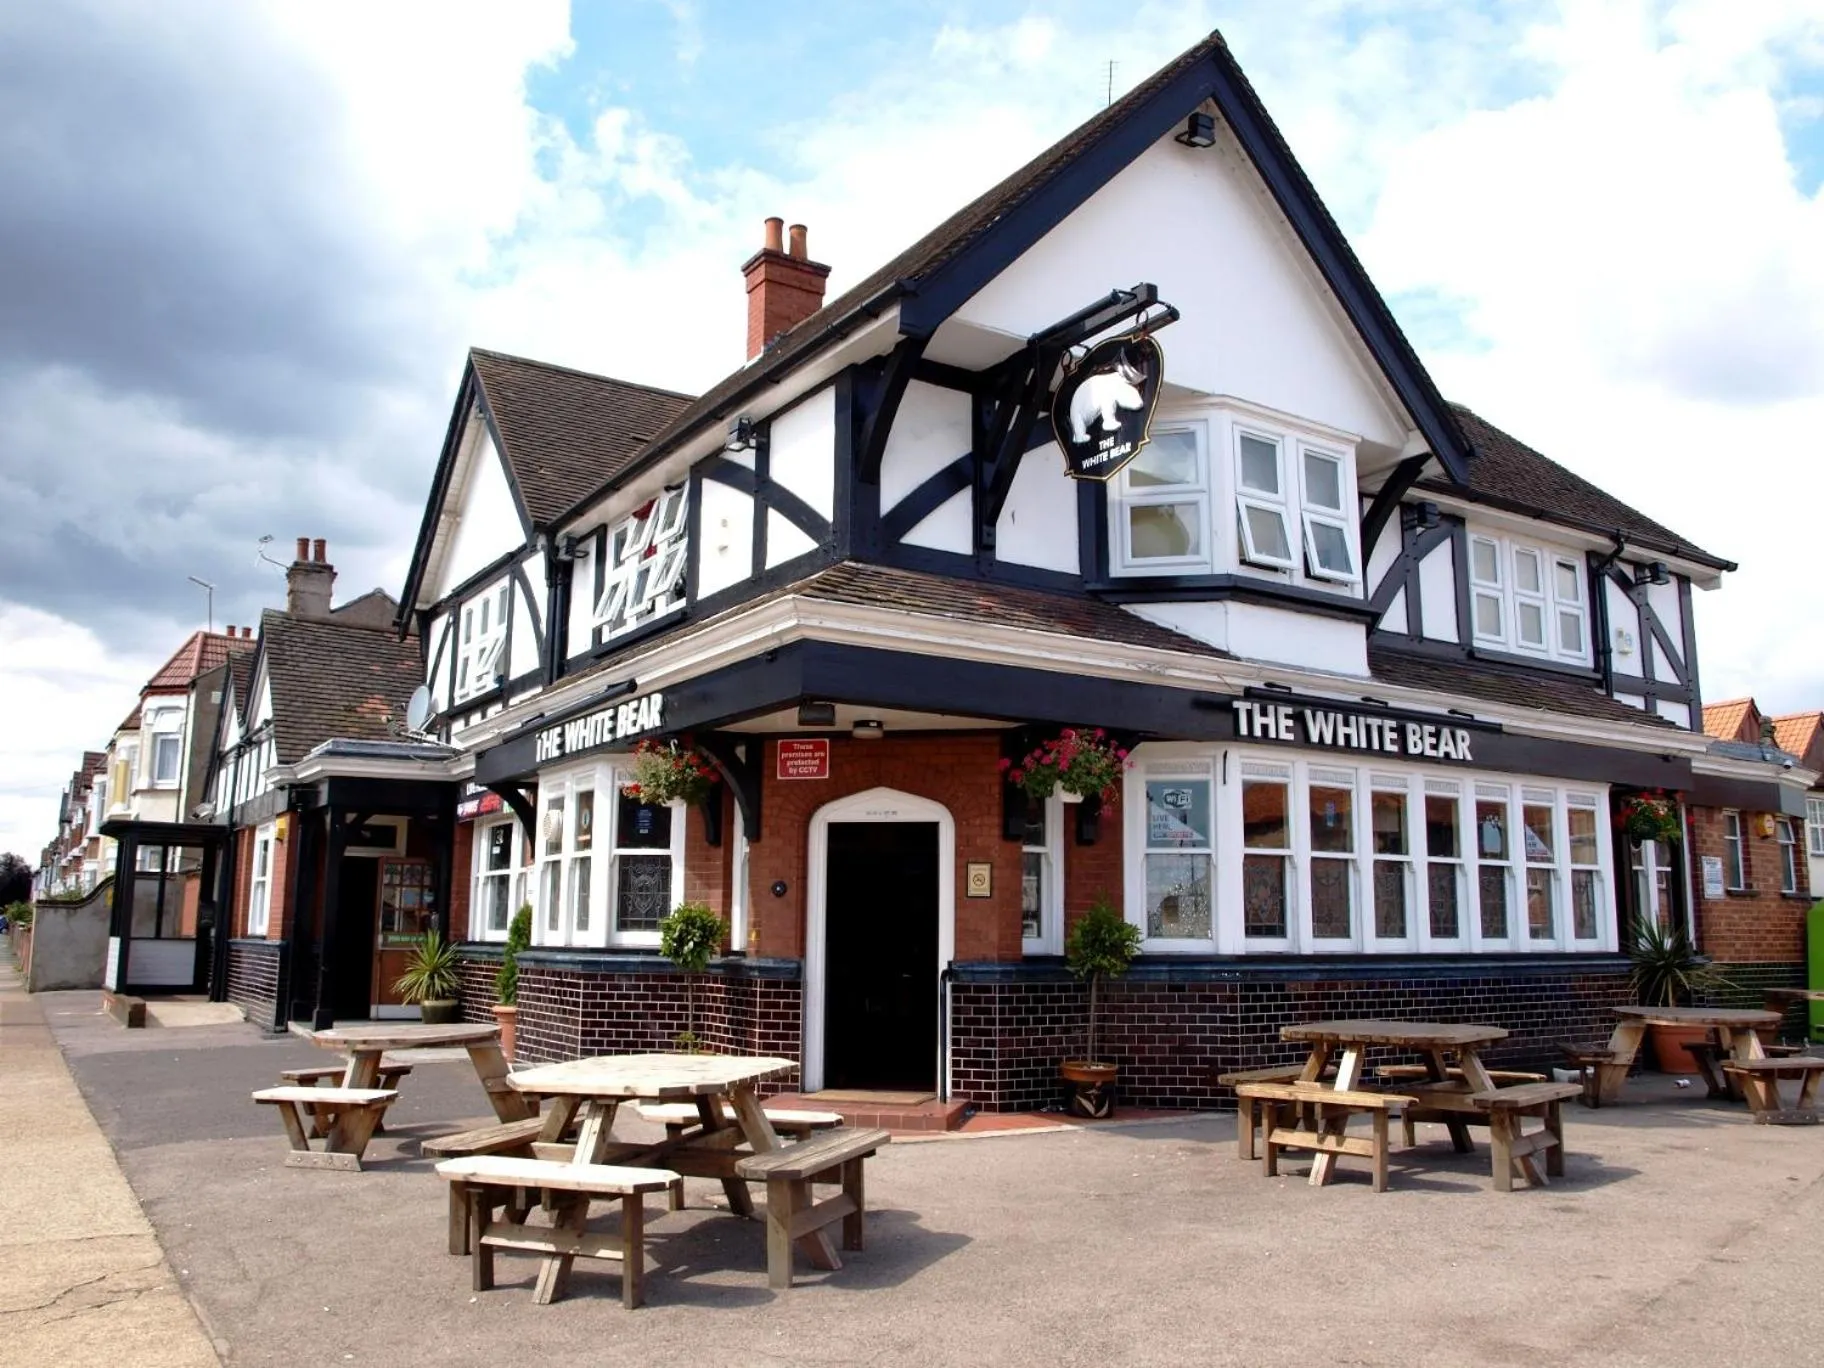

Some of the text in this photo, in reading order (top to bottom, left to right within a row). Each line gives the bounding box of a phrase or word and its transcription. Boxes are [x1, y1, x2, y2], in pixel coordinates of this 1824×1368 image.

[1082, 442, 1132, 470] WHITE BEAR
[1099, 436, 1115, 450] THE
[535, 692, 663, 763] THE WHITE BEAR
[1232, 701, 1474, 761] THE WHITE BEAR
[789, 767, 797, 775] by
